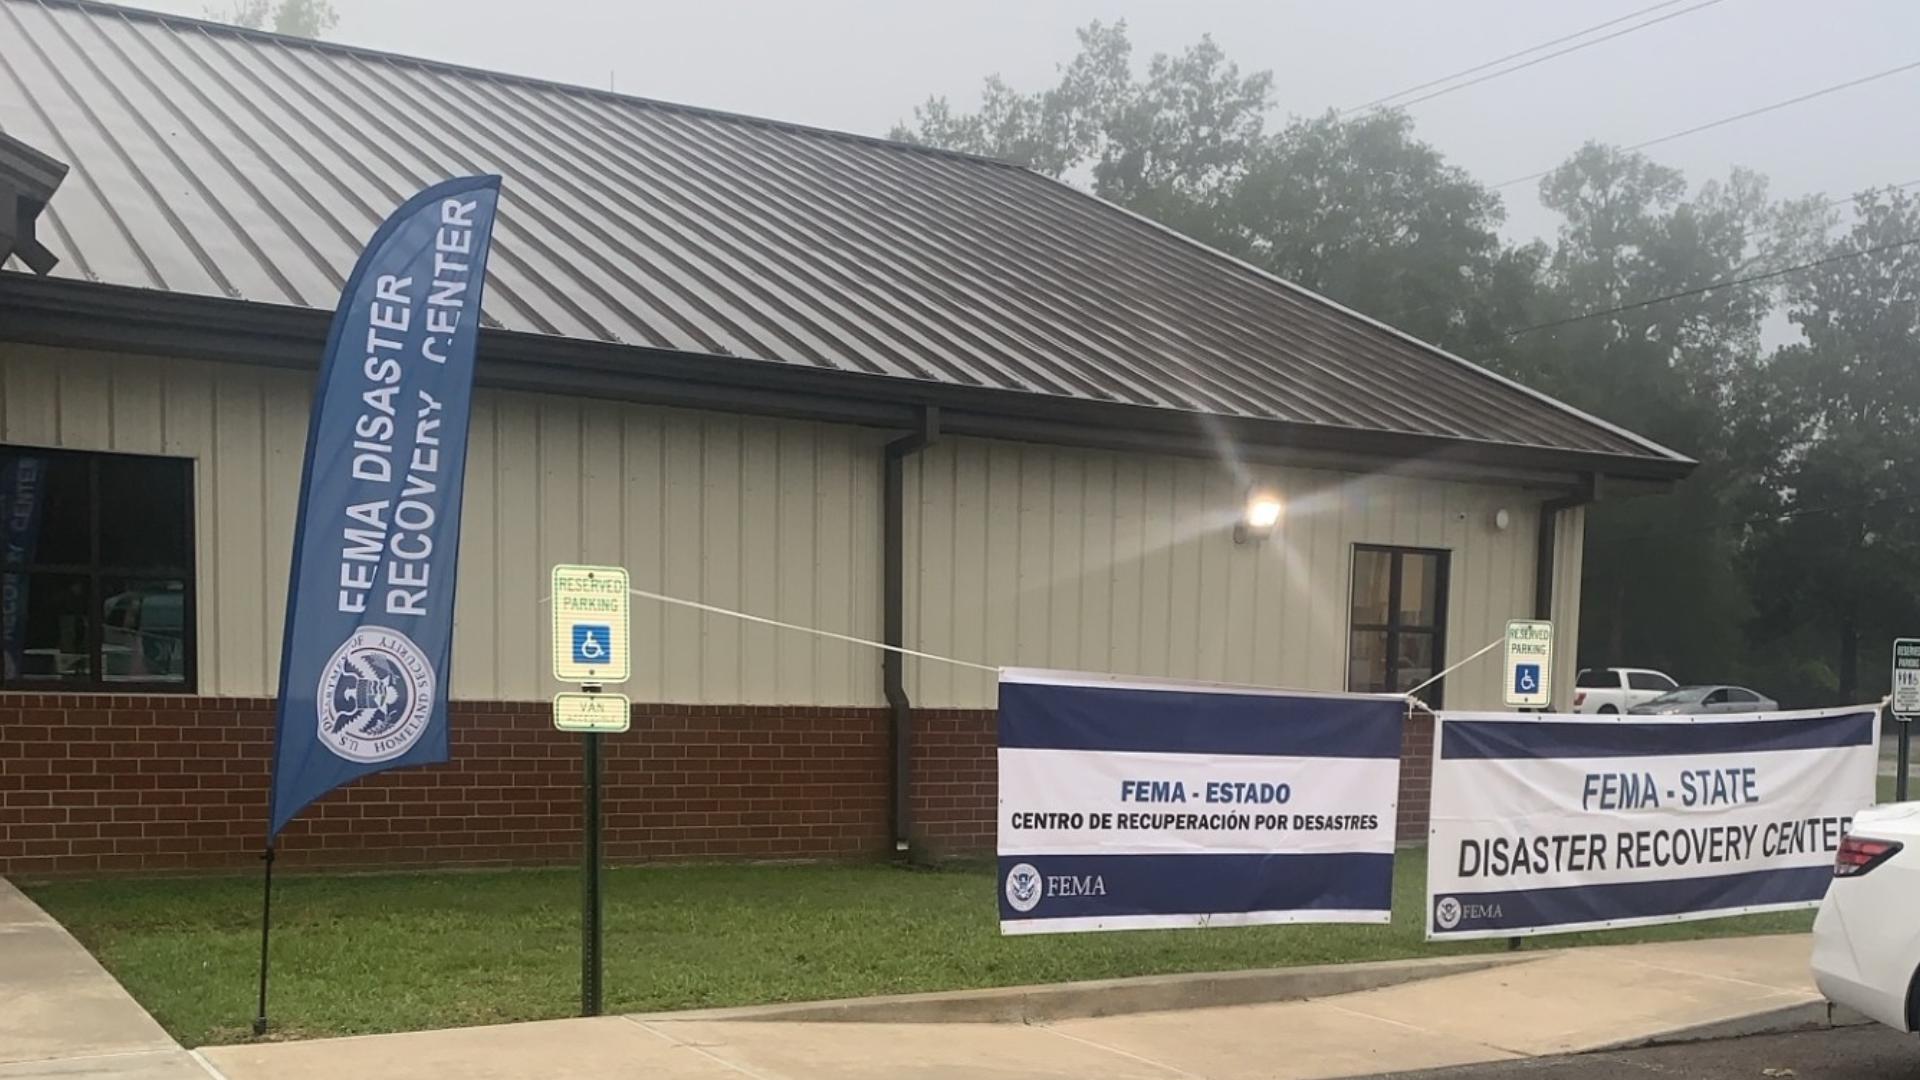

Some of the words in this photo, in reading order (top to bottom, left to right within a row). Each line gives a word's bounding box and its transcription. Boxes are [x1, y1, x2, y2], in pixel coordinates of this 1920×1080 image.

[352, 274, 413, 483] DISASTER
[386, 390, 442, 616] RECOVERY
[421, 198, 477, 364] CENTER
[338, 500, 390, 613] FEMA
[559, 577, 623, 593] RESERVED
[563, 597, 619, 612] PARKING
[379, 636, 429, 689] SECURITY
[374, 693, 429, 753] HOMELAND
[1121, 780, 1187, 803] FEMA
[1205, 782, 1291, 804] ESTADO
[1582, 772, 1660, 812] FEMA
[1680, 767, 1760, 808] STATE
[1011, 813, 1083, 830] CENTRO
[1089, 813, 1112, 830] DE
[1117, 810, 1250, 831] RECUPERACIÓN
[1254, 814, 1288, 831] POR
[1293, 814, 1379, 831] DESASTRES
[1458, 834, 1608, 878] DISASTER
[1616, 824, 1758, 870] RECOVERY
[1047, 875, 1107, 898] FEMA
[1462, 903, 1504, 920] FEMA
